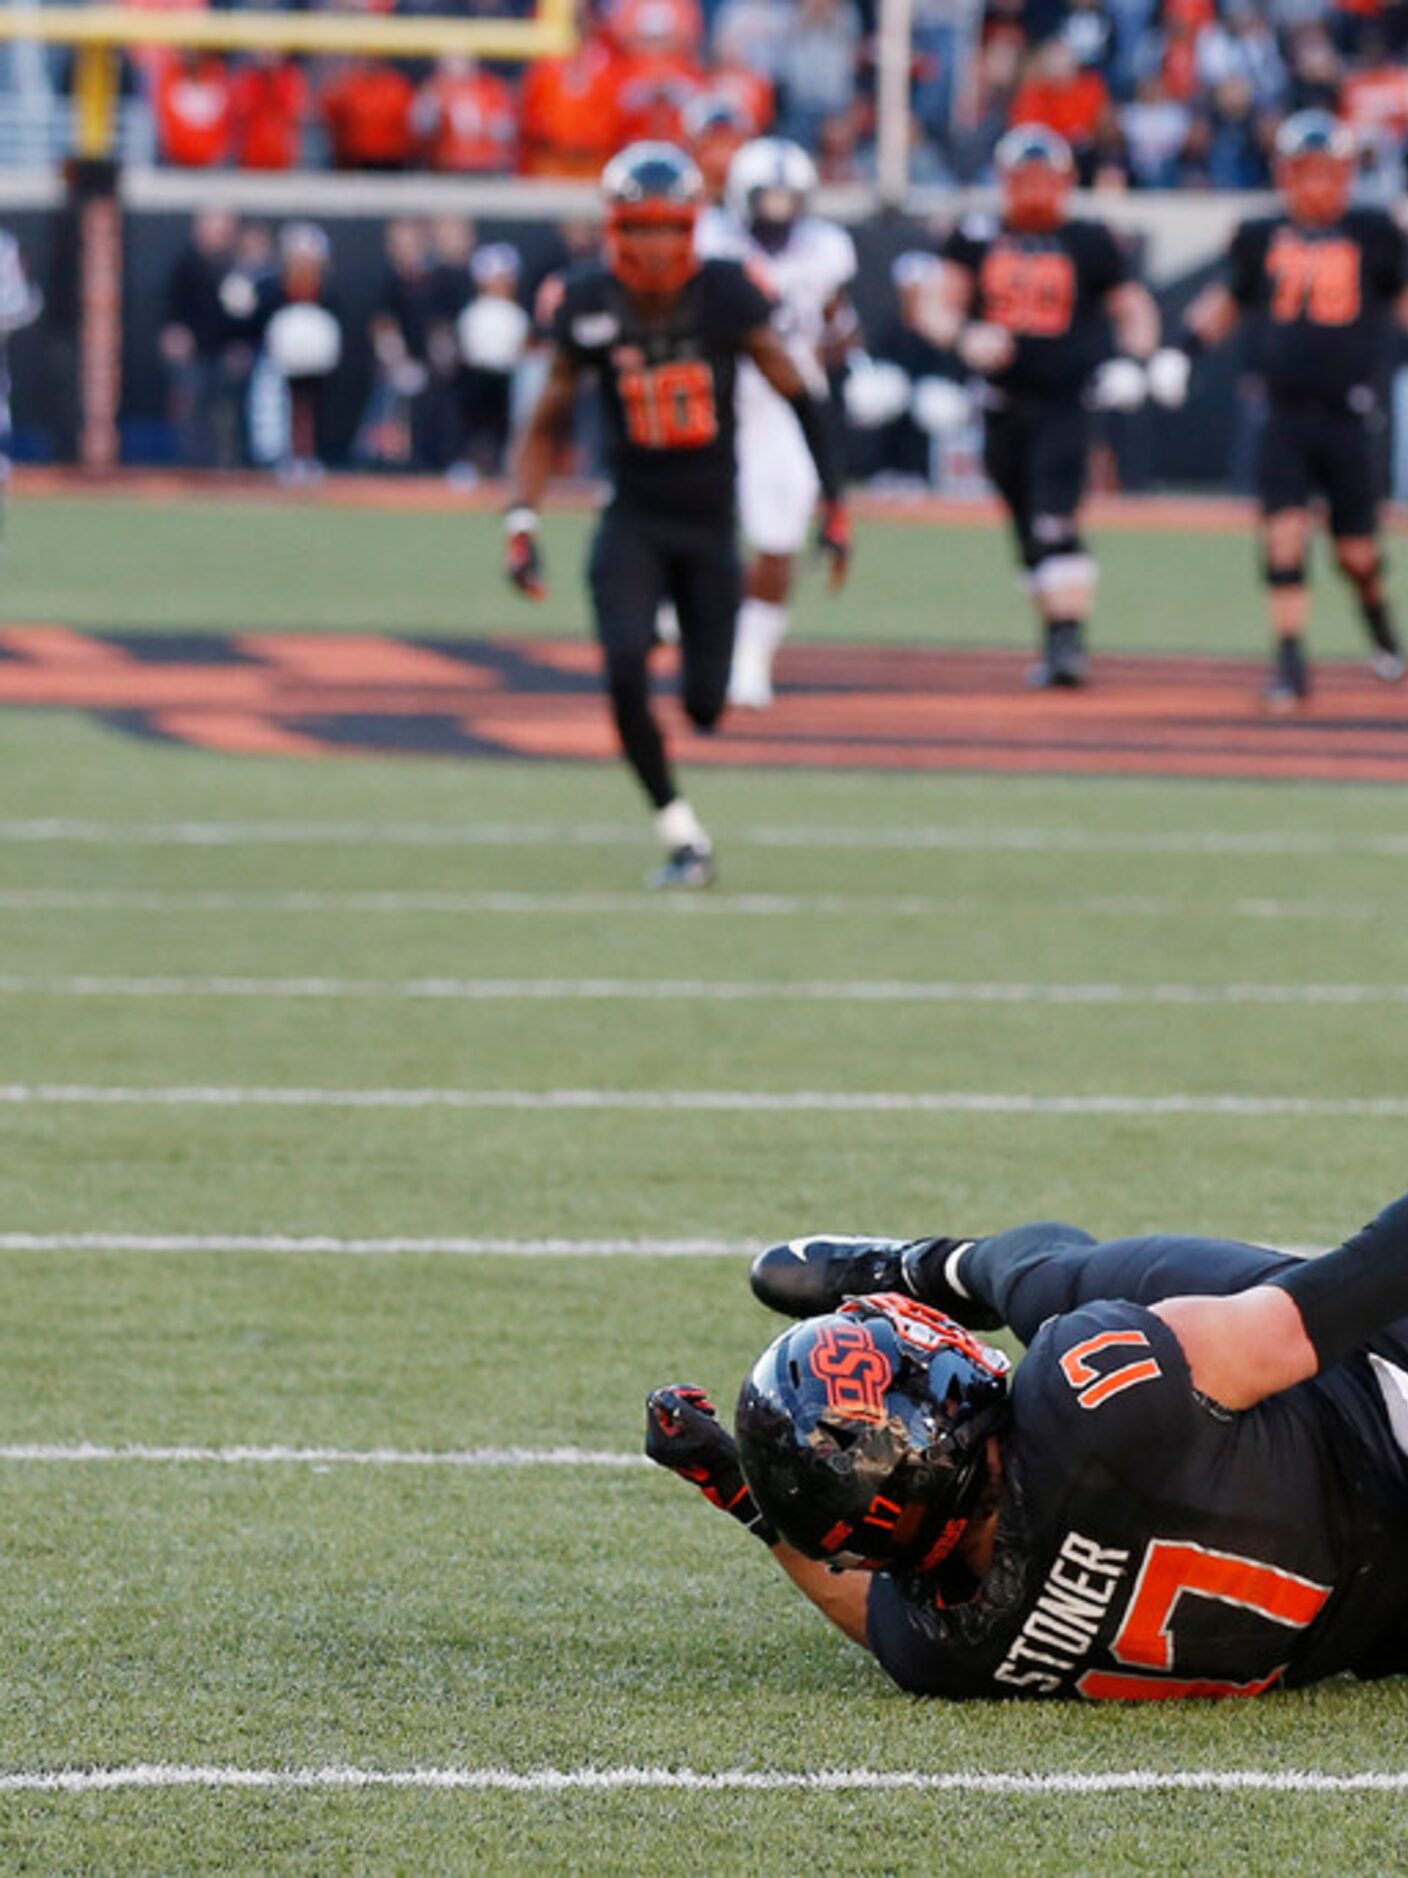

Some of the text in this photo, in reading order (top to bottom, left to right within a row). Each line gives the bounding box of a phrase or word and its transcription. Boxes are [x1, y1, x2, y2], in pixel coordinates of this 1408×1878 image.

[618, 361, 718, 448] 10
[1059, 1330, 1162, 1409] 17
[862, 1494, 902, 1531] 17
[993, 1530, 1130, 1692] STONER
